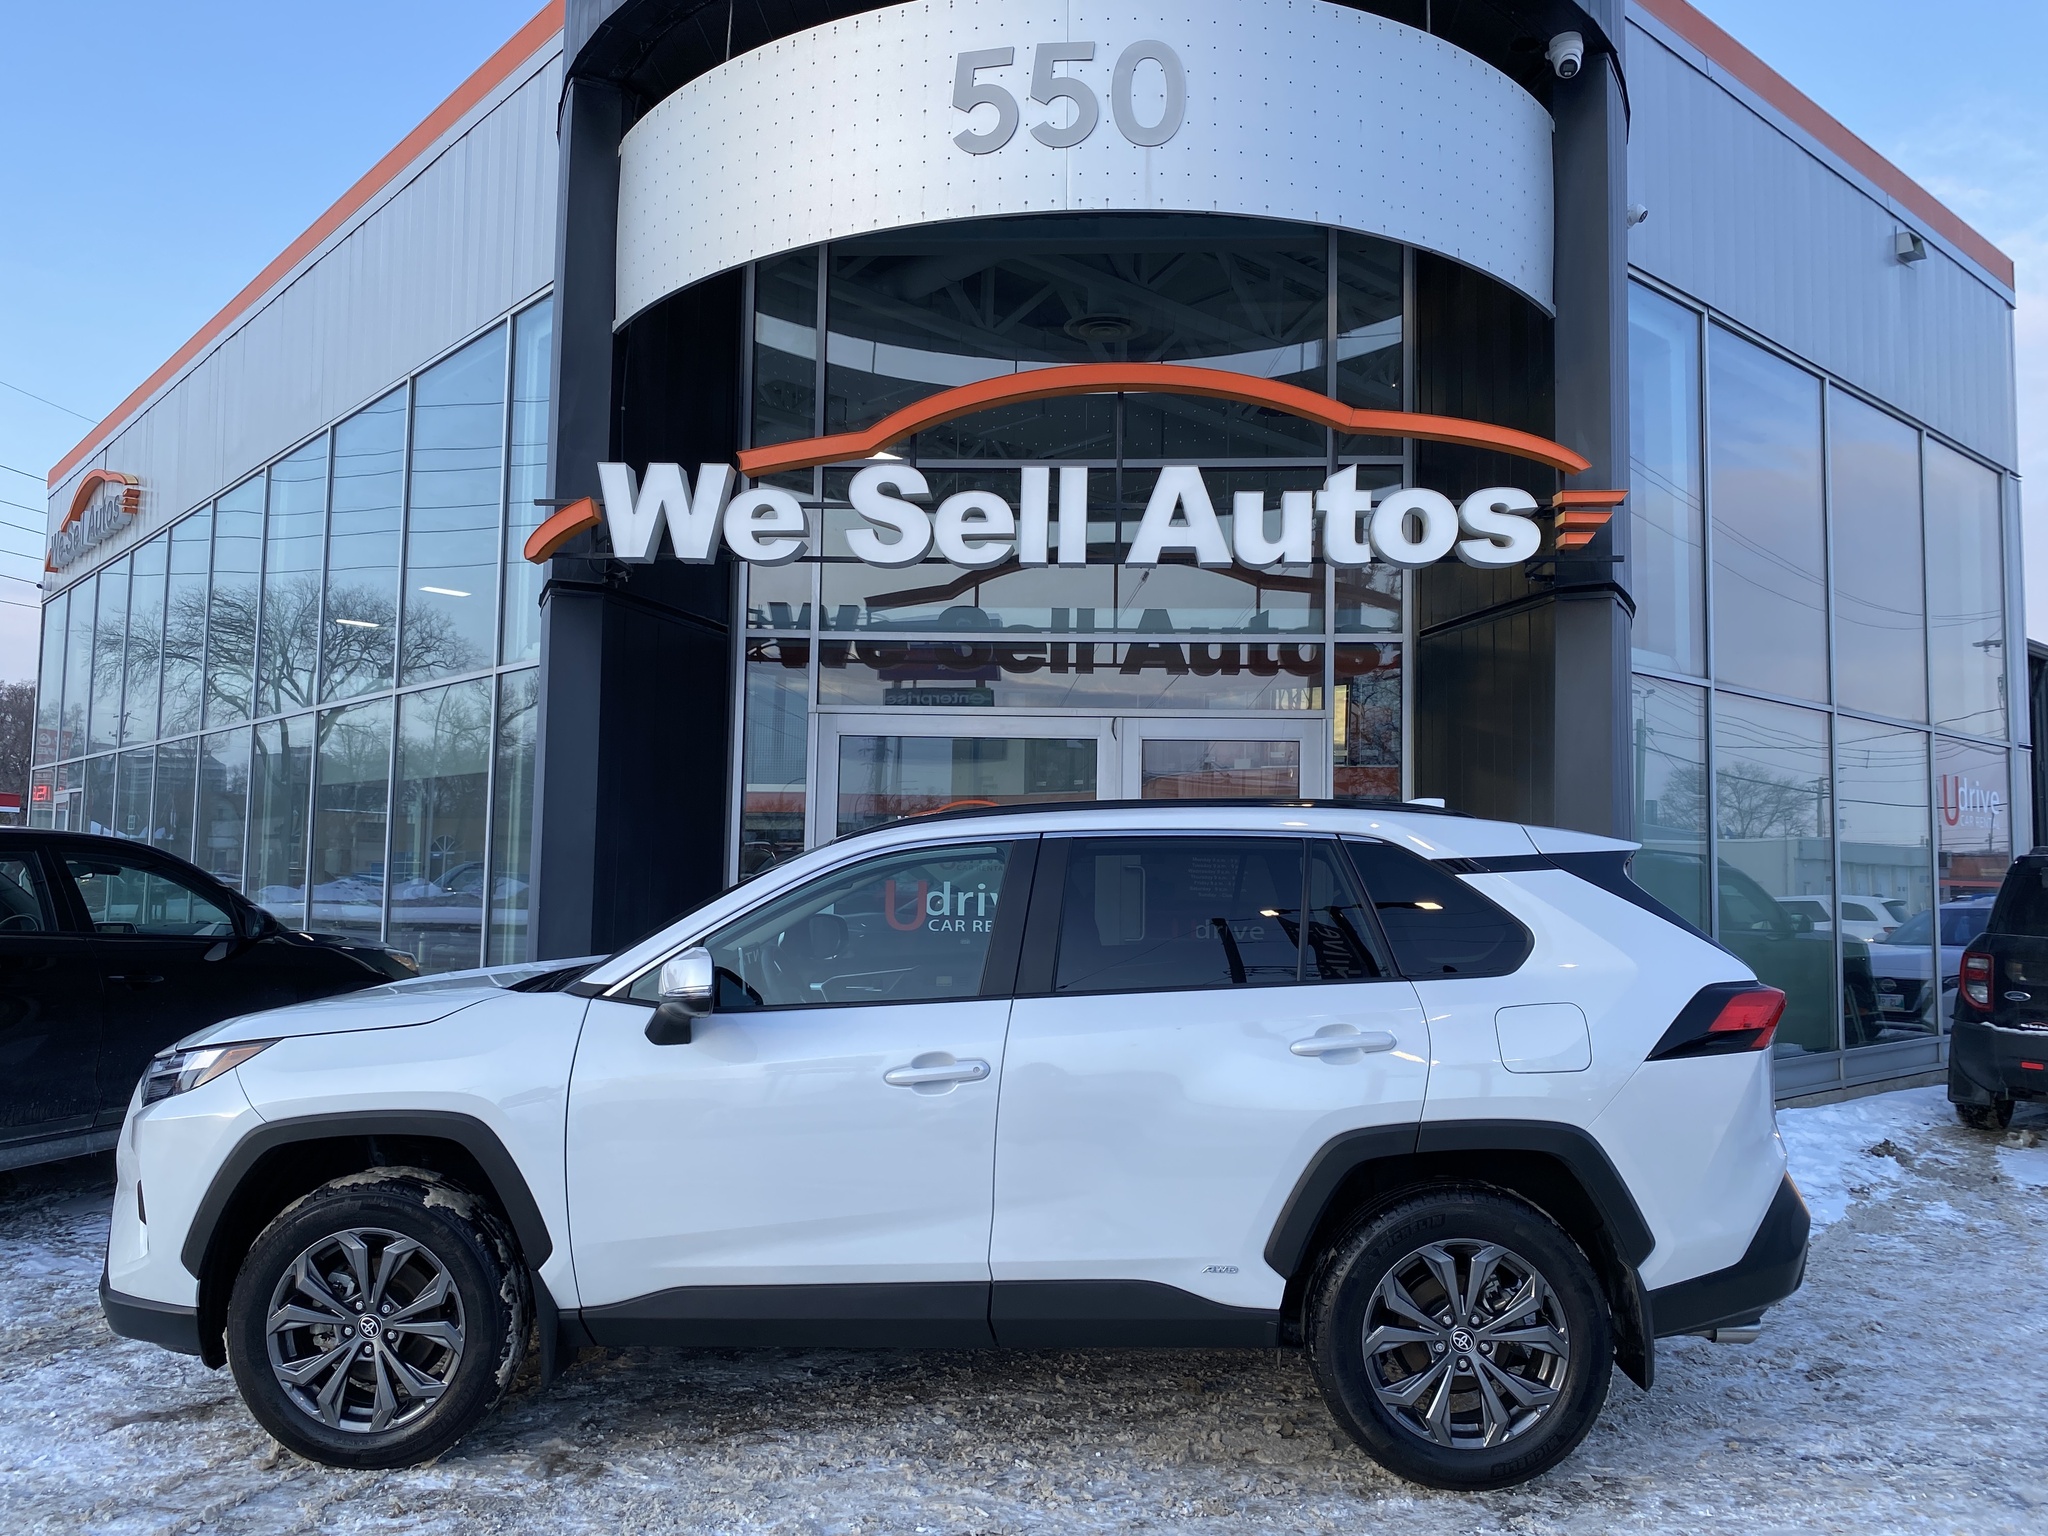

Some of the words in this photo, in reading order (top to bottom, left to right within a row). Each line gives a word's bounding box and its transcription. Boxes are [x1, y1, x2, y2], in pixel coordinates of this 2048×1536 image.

[952, 39, 1187, 155] 550
[87, 494, 122, 543] Autos
[596, 461, 811, 568] We
[845, 462, 1089, 571] Sell
[1125, 462, 1542, 571] Autos
[1942, 773, 2001, 828] Udrive
[928, 919, 966, 932] CAR
[1201, 1264, 1239, 1274] AWD
